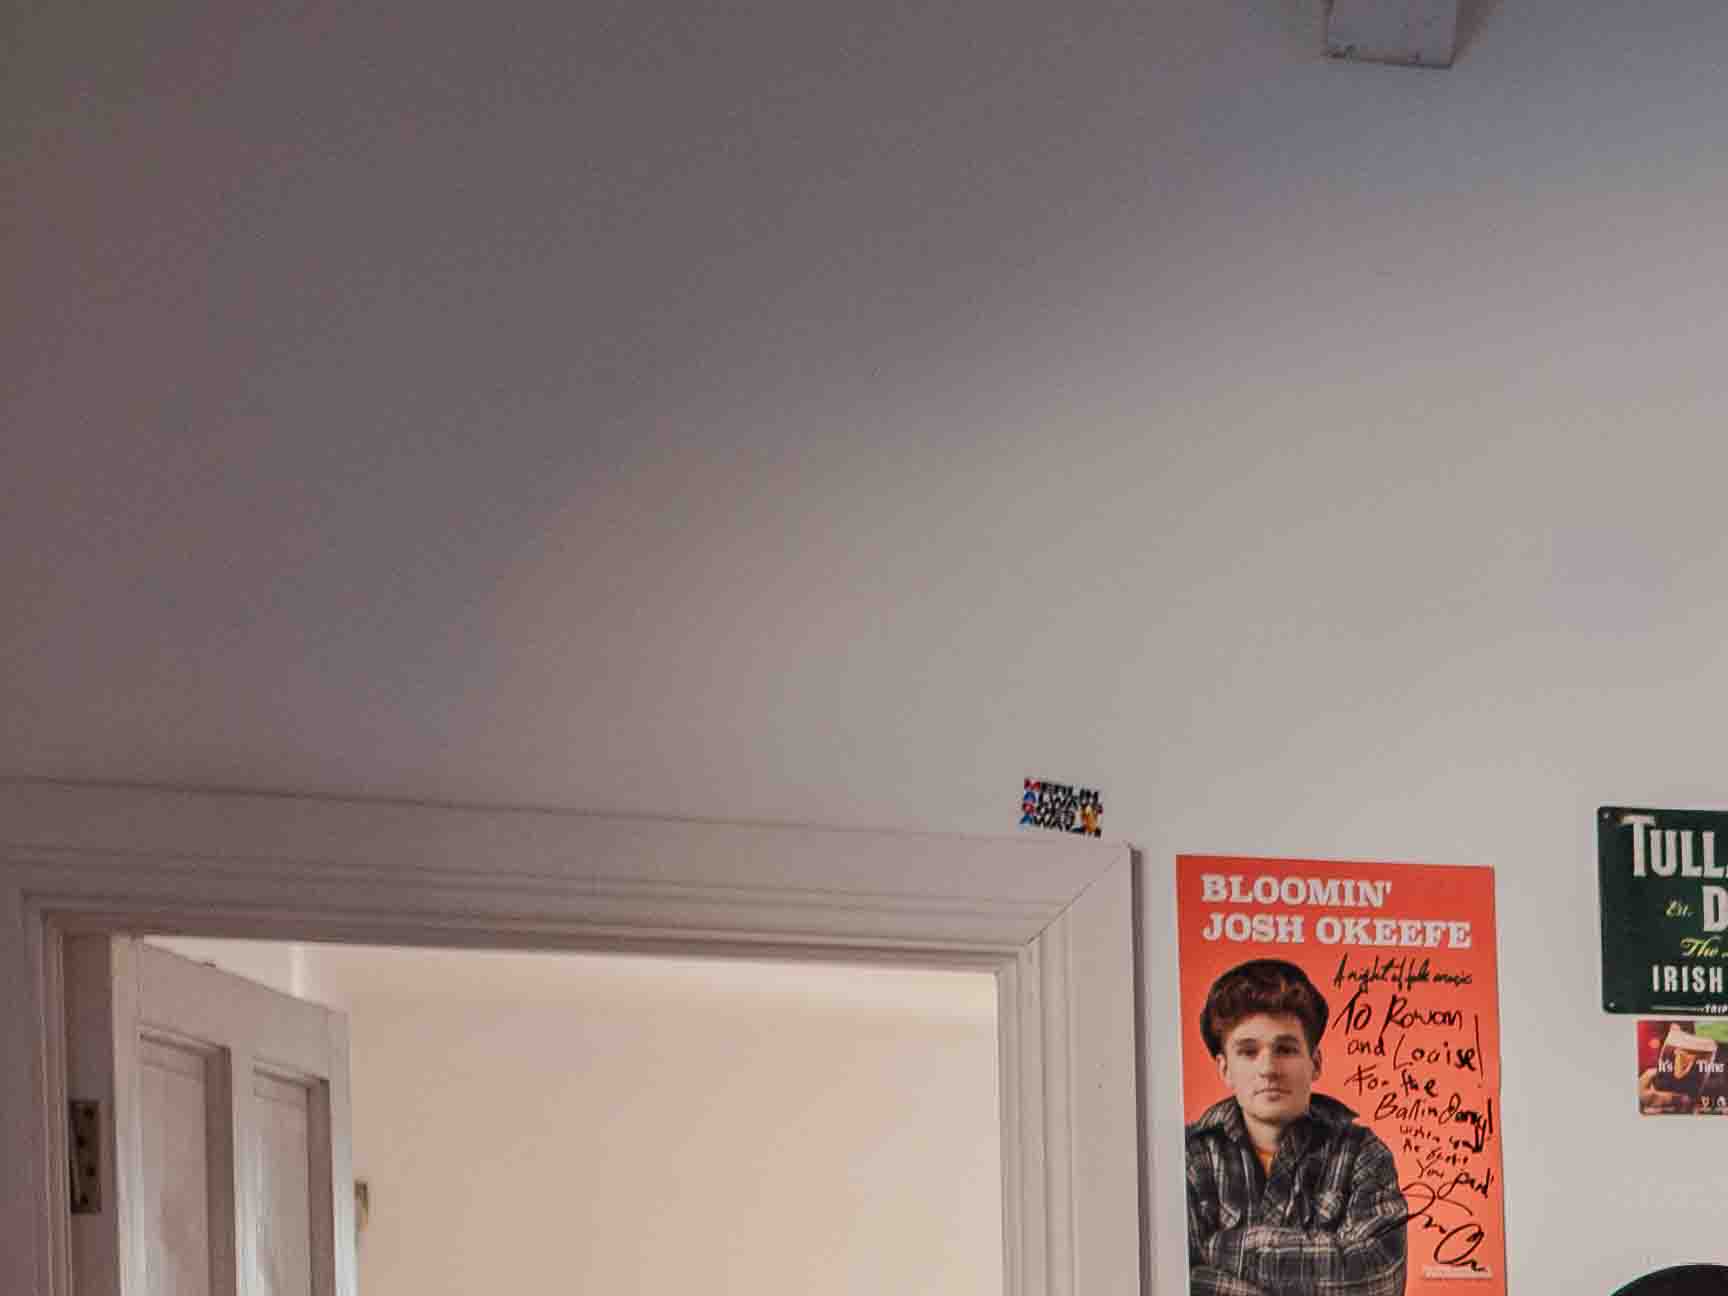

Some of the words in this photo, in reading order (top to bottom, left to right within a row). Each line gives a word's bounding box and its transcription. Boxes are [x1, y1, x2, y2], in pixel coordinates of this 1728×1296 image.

[1200, 873, 1392, 909] BLOOMIN'
[1202, 912, 1305, 944] JOSH
[1315, 916, 1472, 950] OKEEFE
[1680, 936, 1720, 958] The
[1652, 963, 1724, 993] IRISH
